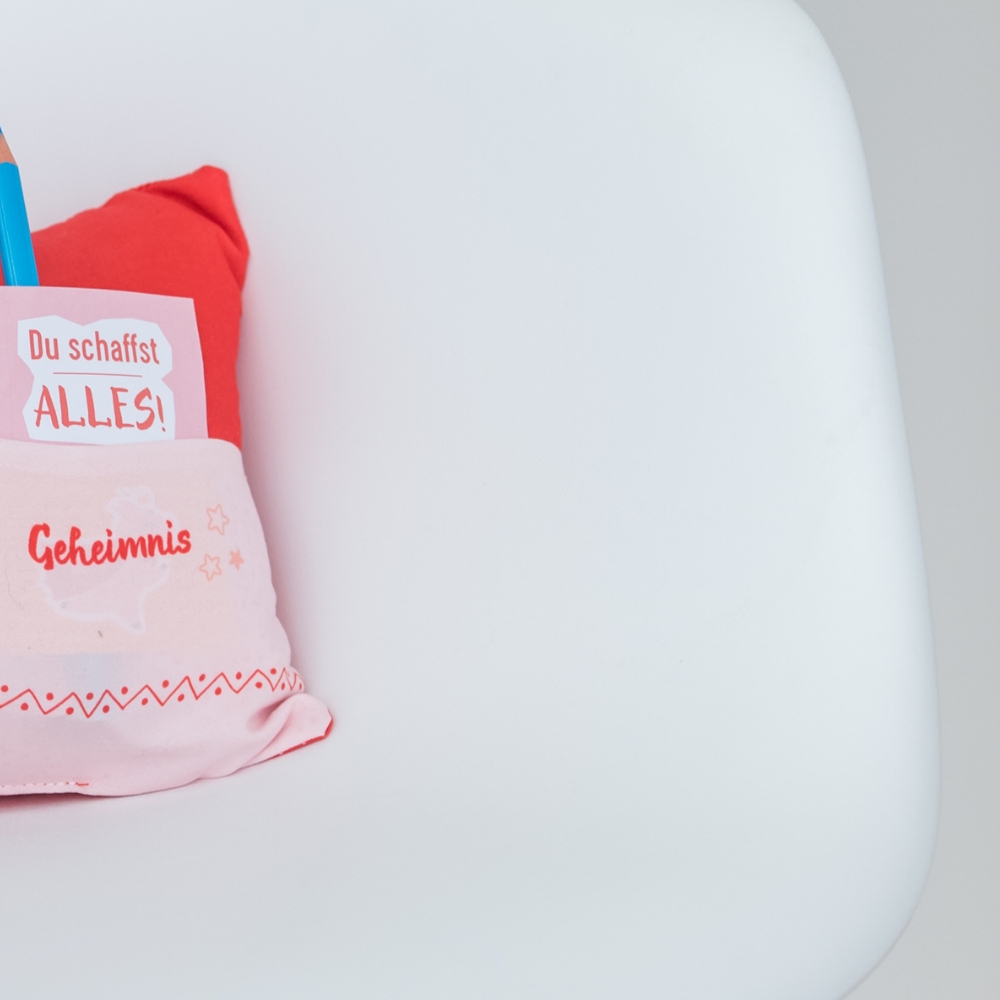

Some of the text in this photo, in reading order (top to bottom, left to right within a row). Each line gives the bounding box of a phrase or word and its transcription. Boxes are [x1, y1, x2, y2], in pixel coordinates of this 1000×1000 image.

[28, 329, 160, 364] Du schaffst
[33, 385, 166, 432] ALLES!
[28, 520, 192, 571] Geheimnis
